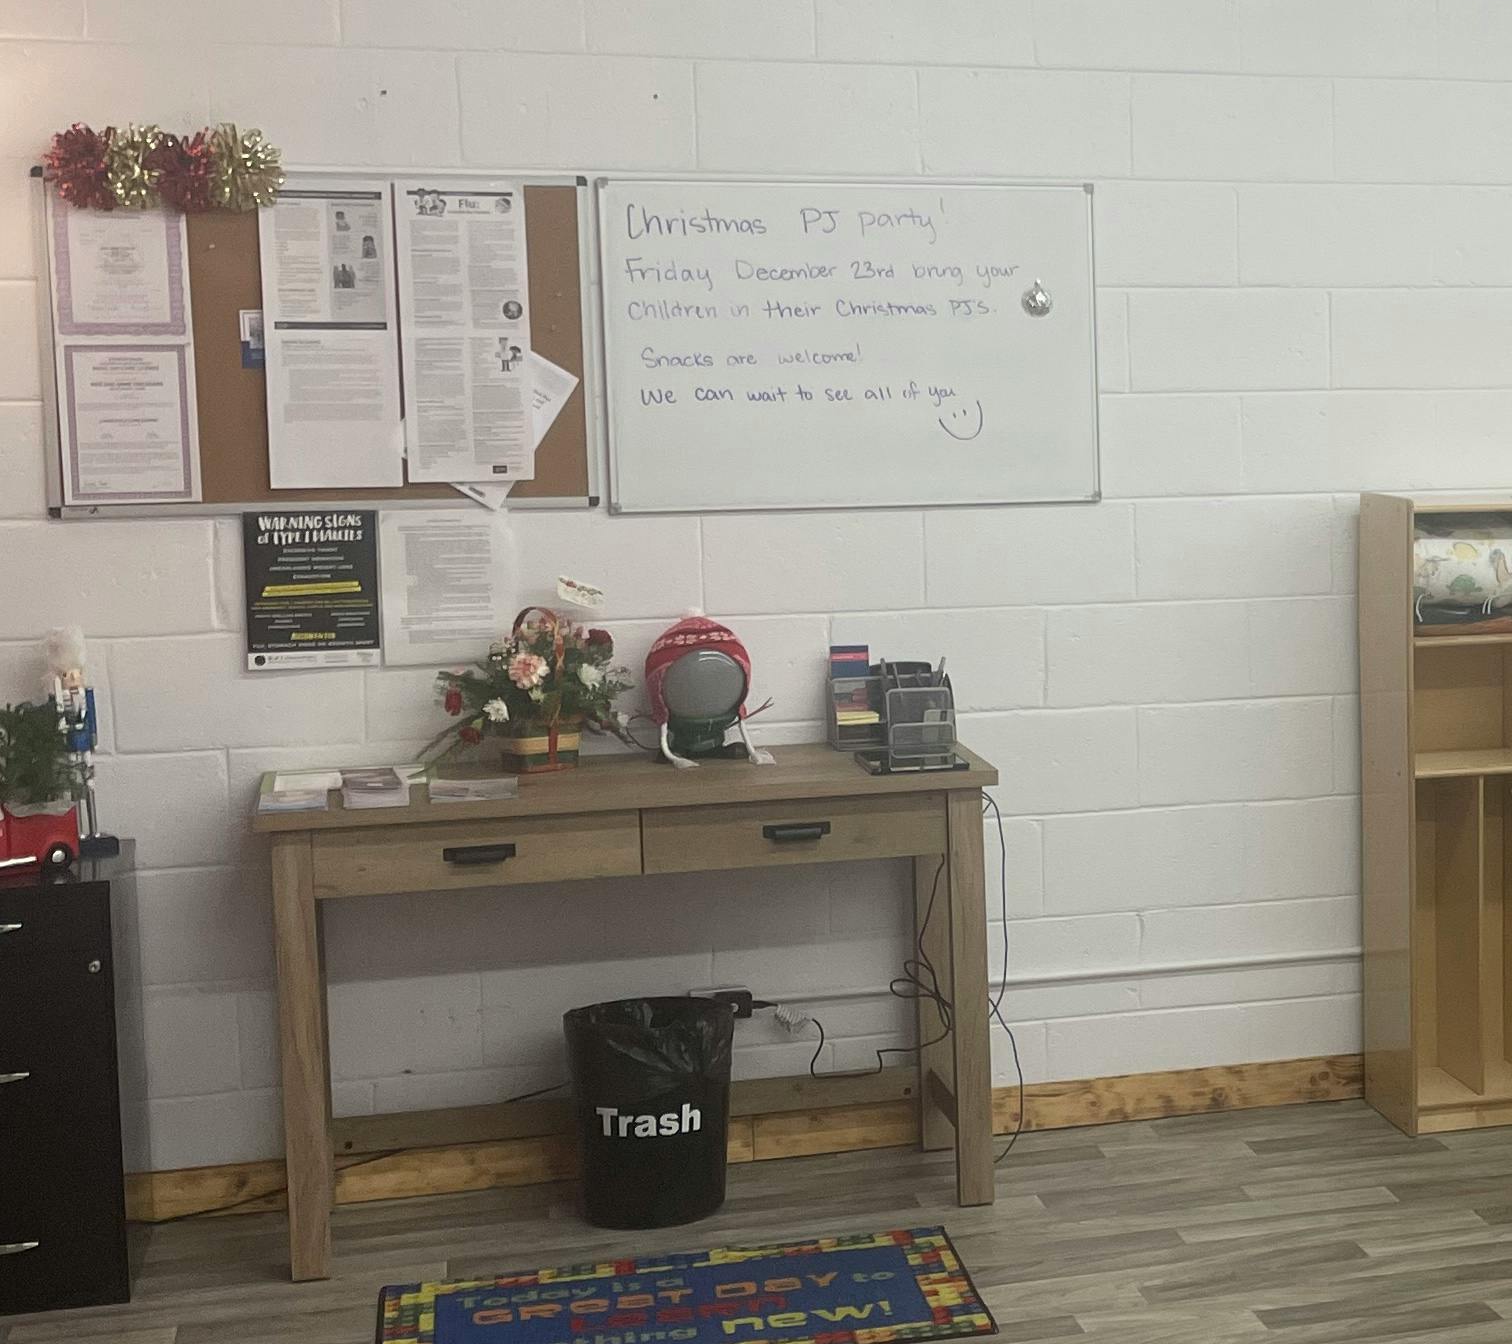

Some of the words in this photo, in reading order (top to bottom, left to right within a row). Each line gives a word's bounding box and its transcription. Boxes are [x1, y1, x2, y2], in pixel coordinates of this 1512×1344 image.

[626, 203, 767, 240] Christmas
[800, 207, 840, 233] PJ
[625, 257, 713, 292] Friday
[735, 259, 838, 281] December
[851, 260, 895, 281] 23rd
[912, 263, 963, 287] bring
[976, 264, 1020, 289] your
[731, 304, 750, 319] in
[763, 299, 821, 320] their
[836, 299, 937, 318] Christmas
[641, 346, 714, 368] Snacks
[727, 353, 757, 367] are
[777, 343, 861, 365] welcome!
[641, 387, 678, 406] We
[695, 386, 734, 401] can
[747, 386, 788, 402] wait
[796, 384, 814, 402] to
[824, 386, 853, 402] see
[864, 386, 892, 402] all
[902, 381, 920, 400] of
[928, 386, 956, 407] you
[258, 515, 322, 531] WARNING
[324, 514, 363, 529] SIGNS
[596, 1103, 702, 1139] Trash
[852, 1271, 897, 1283] to
[456, 1285, 598, 1310] Today
[611, 1281, 641, 1293] is
[656, 1278, 685, 1289] a
[721, 1300, 893, 1336] new!
